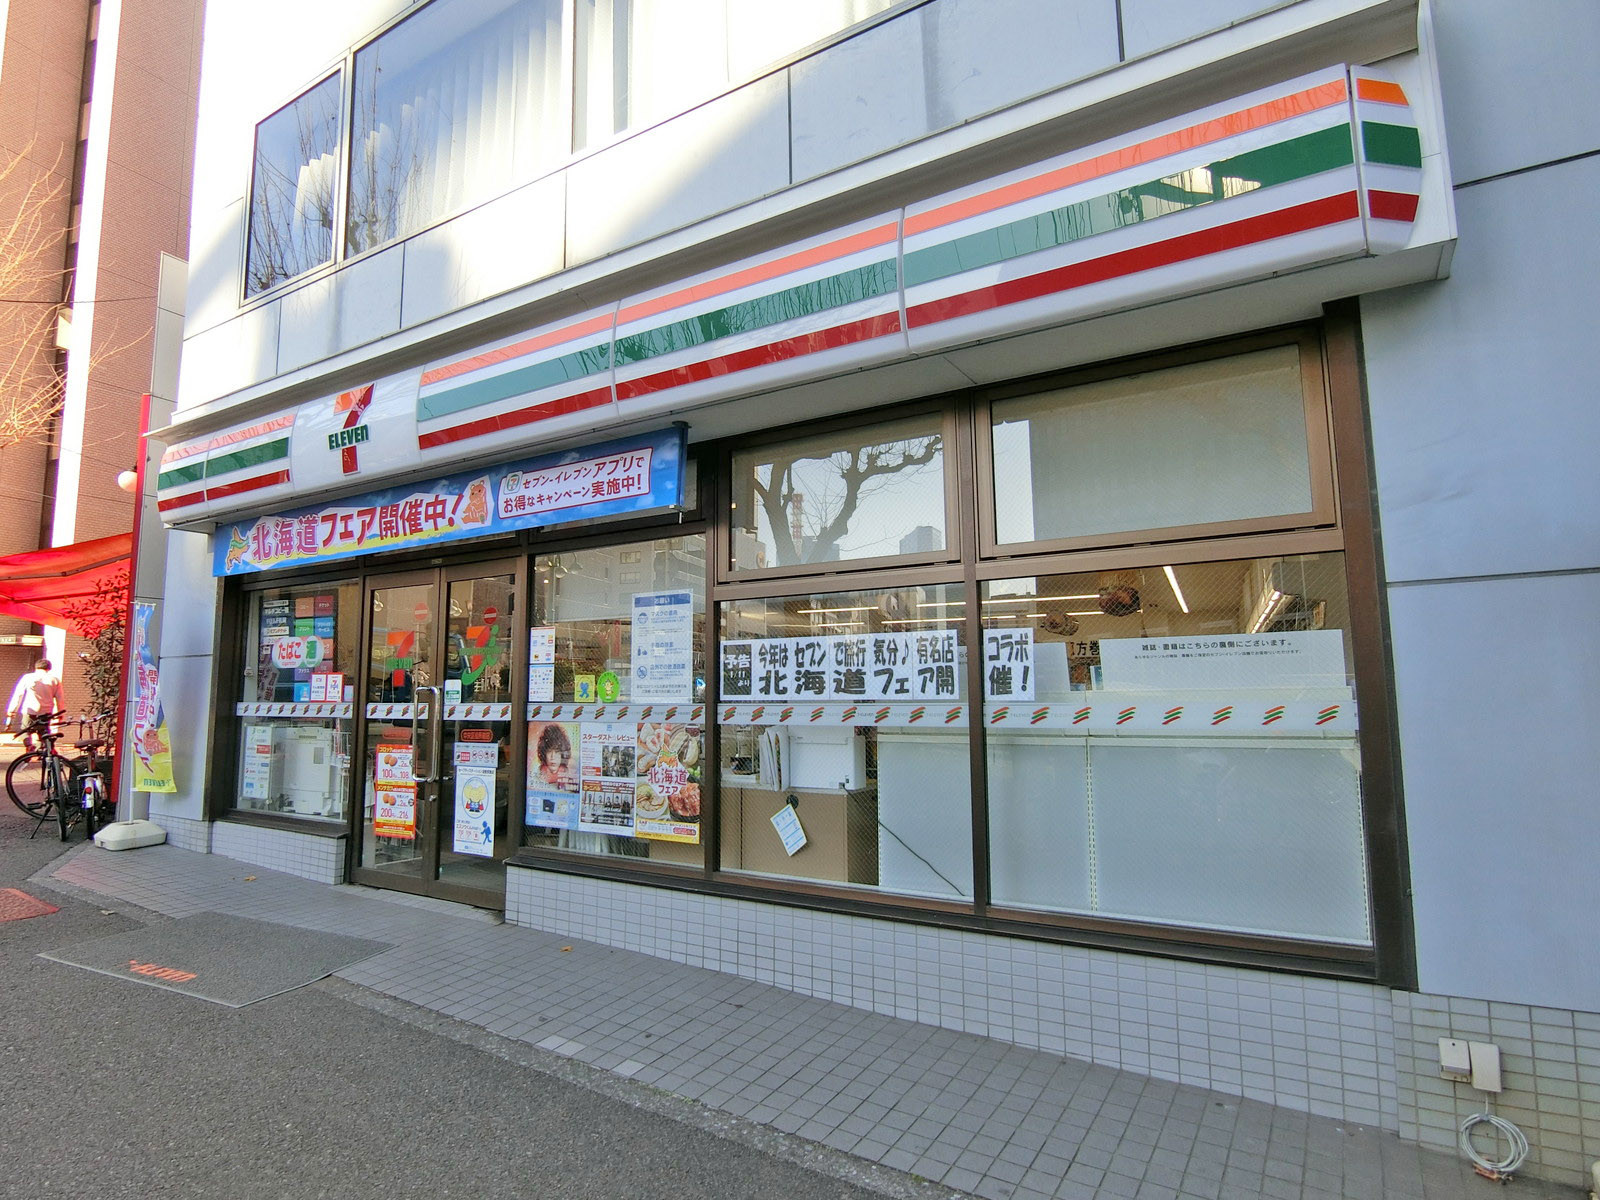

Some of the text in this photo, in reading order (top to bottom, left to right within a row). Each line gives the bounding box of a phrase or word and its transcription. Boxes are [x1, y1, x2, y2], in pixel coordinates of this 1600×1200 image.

[503, 474, 642, 514] お得なキャンペーン実施中!
[252, 493, 464, 563] 北海道フェア開催中!
[278, 641, 302, 660] たばこ
[724, 654, 751, 669] 予告
[647, 768, 687, 786] 北海道
[658, 785, 679, 796] フェア
